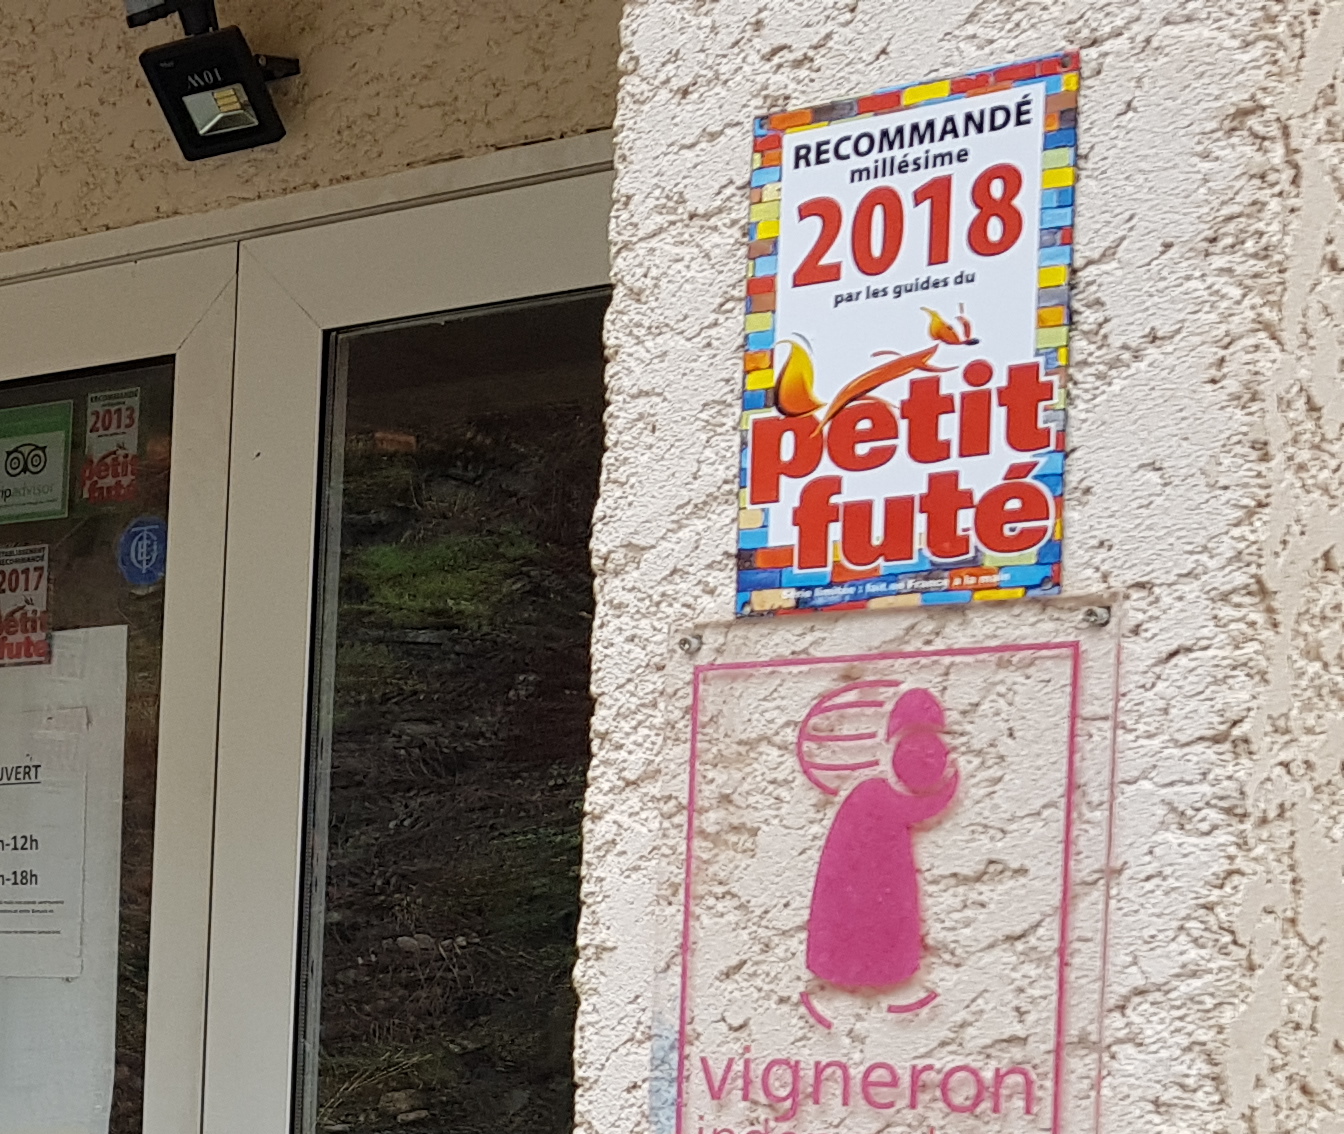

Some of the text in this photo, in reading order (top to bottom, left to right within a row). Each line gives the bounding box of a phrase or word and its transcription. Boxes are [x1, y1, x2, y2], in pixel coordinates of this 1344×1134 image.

[792, 95, 1034, 169] RECOMMANDÉ
[849, 147, 970, 184] millésime
[792, 162, 1024, 288] 2018
[833, 270, 976, 308] par les guides du
[89, 405, 136, 433] 2013
[750, 359, 1054, 505] petit
[81, 450, 140, 487] petit
[792, 461, 1051, 570] futé
[699, 1045, 1038, 1122] vigneron
